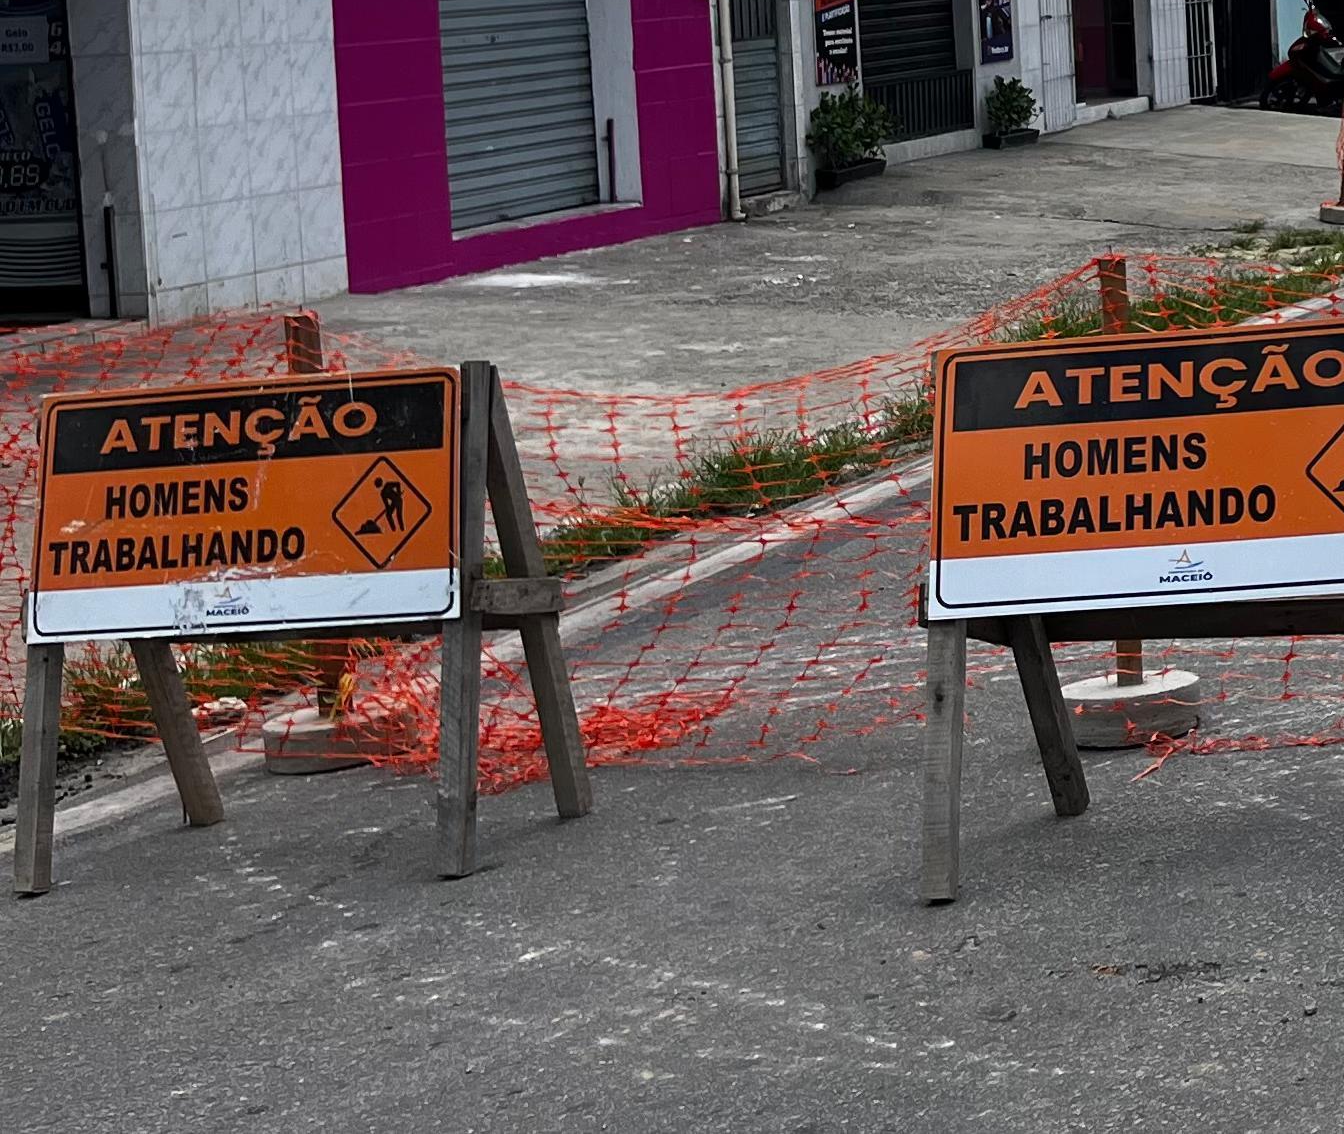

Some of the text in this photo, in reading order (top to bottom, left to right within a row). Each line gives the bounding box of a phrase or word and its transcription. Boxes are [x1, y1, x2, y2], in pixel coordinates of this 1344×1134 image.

[100, 396, 377, 455] ATENÇÃO
[1024, 432, 1207, 480] HOMENS
[105, 477, 249, 520] HOMENS
[953, 484, 1276, 541] TRABALHANDO
[49, 527, 305, 576] TRABALHANDO
